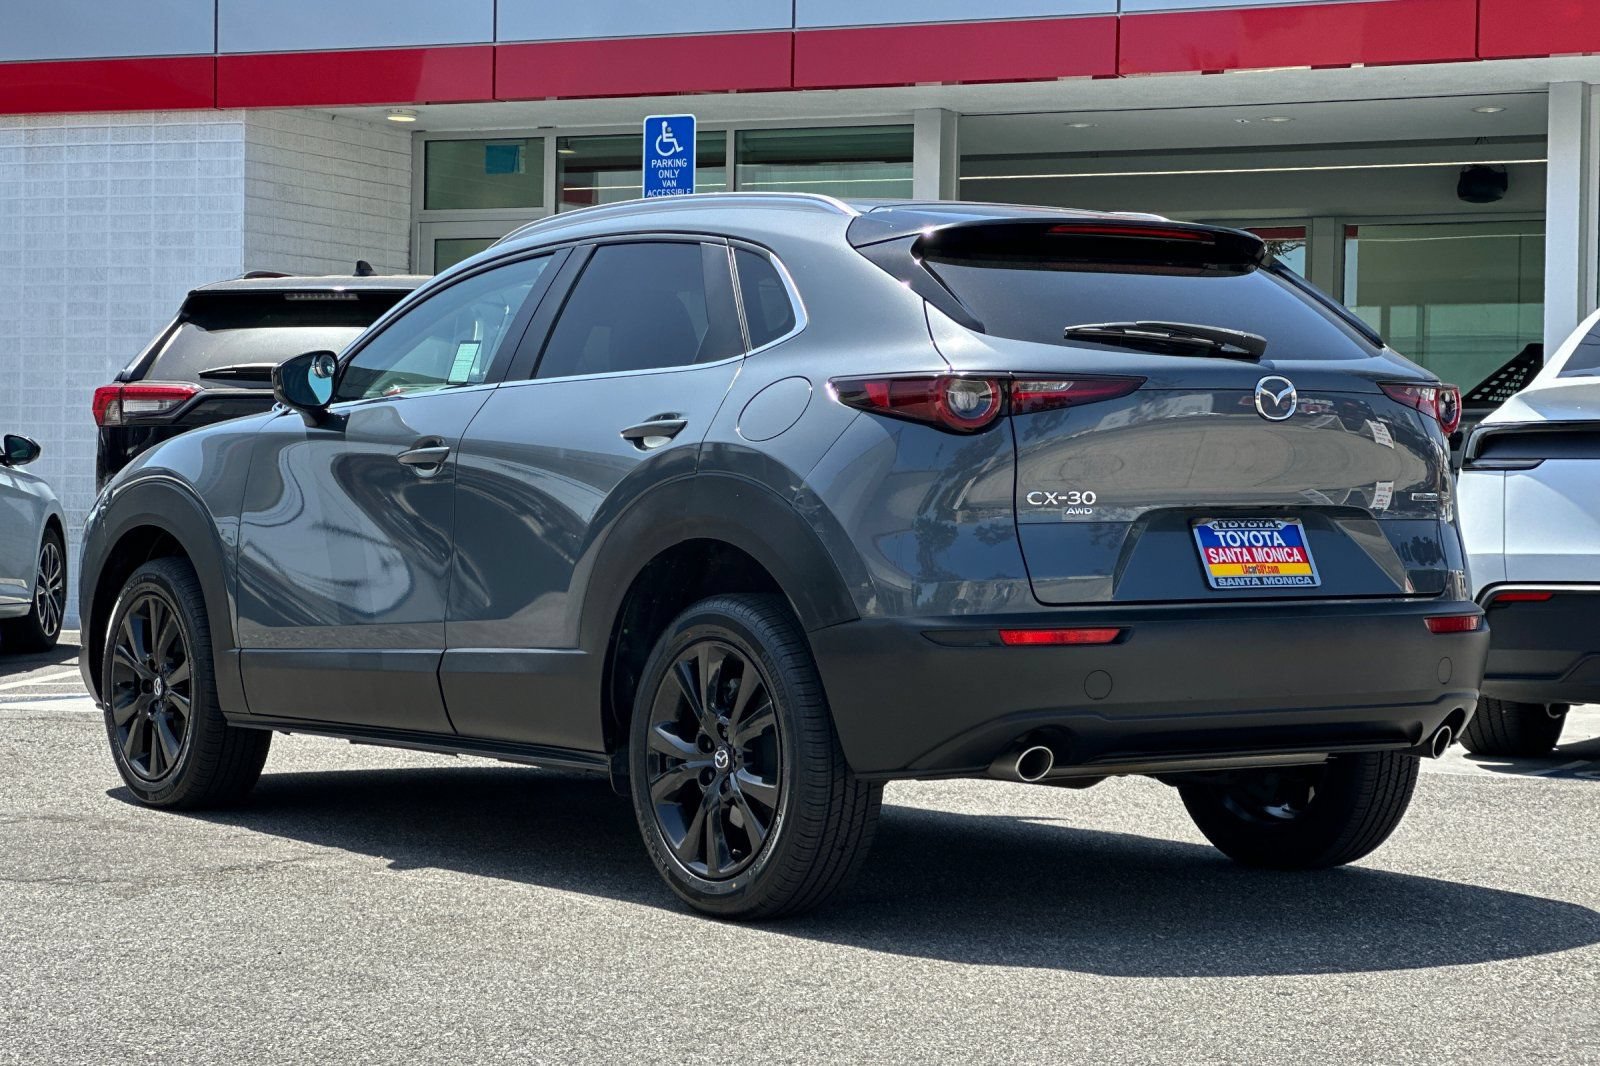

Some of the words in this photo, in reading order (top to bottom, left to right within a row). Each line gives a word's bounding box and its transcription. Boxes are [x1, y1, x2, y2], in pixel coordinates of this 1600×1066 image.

[651, 159, 687, 168] PARKING
[658, 169, 680, 179] ONLY
[662, 179, 676, 187] VAN
[1026, 490, 1097, 505] CX-30
[1065, 507, 1093, 515] AWD
[1218, 519, 1276, 529] TOYOTA
[1214, 531, 1286, 547] TOYOTA
[1208, 547, 1252, 564] SANTA
[1252, 547, 1303, 563] MONICA
[1218, 577, 1260, 586] SANTA
[1263, 576, 1313, 586] MONICA
